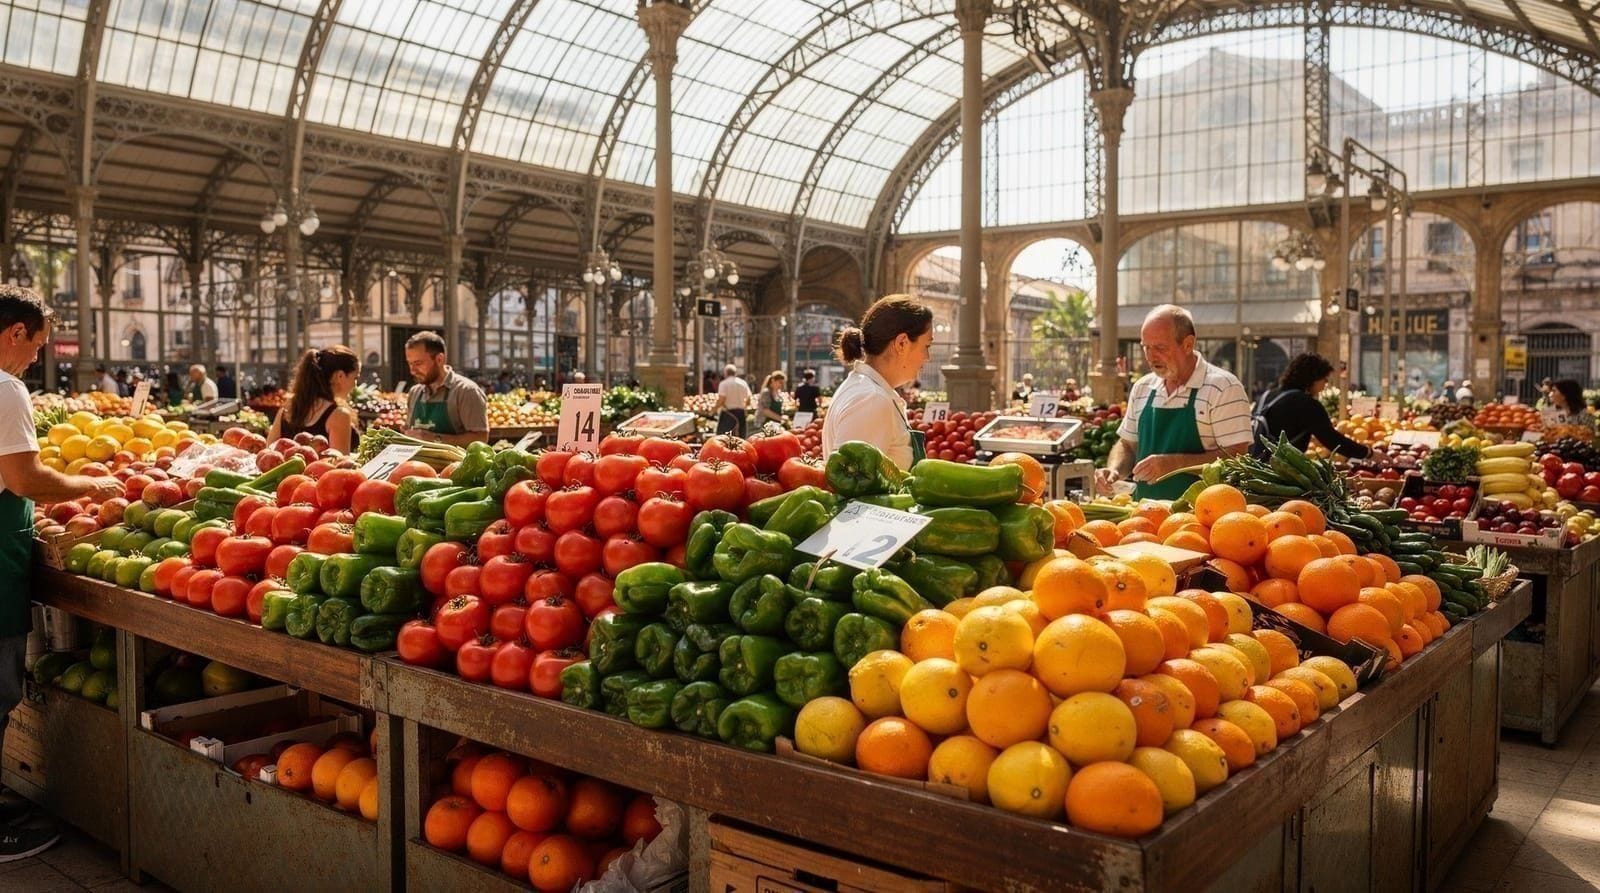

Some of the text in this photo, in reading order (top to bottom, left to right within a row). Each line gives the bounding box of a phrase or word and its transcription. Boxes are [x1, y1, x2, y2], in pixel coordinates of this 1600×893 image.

[931, 408, 946, 420] 18
[1040, 402, 1055, 418] 12
[574, 411, 595, 442] 14
[850, 534, 898, 565] 2
